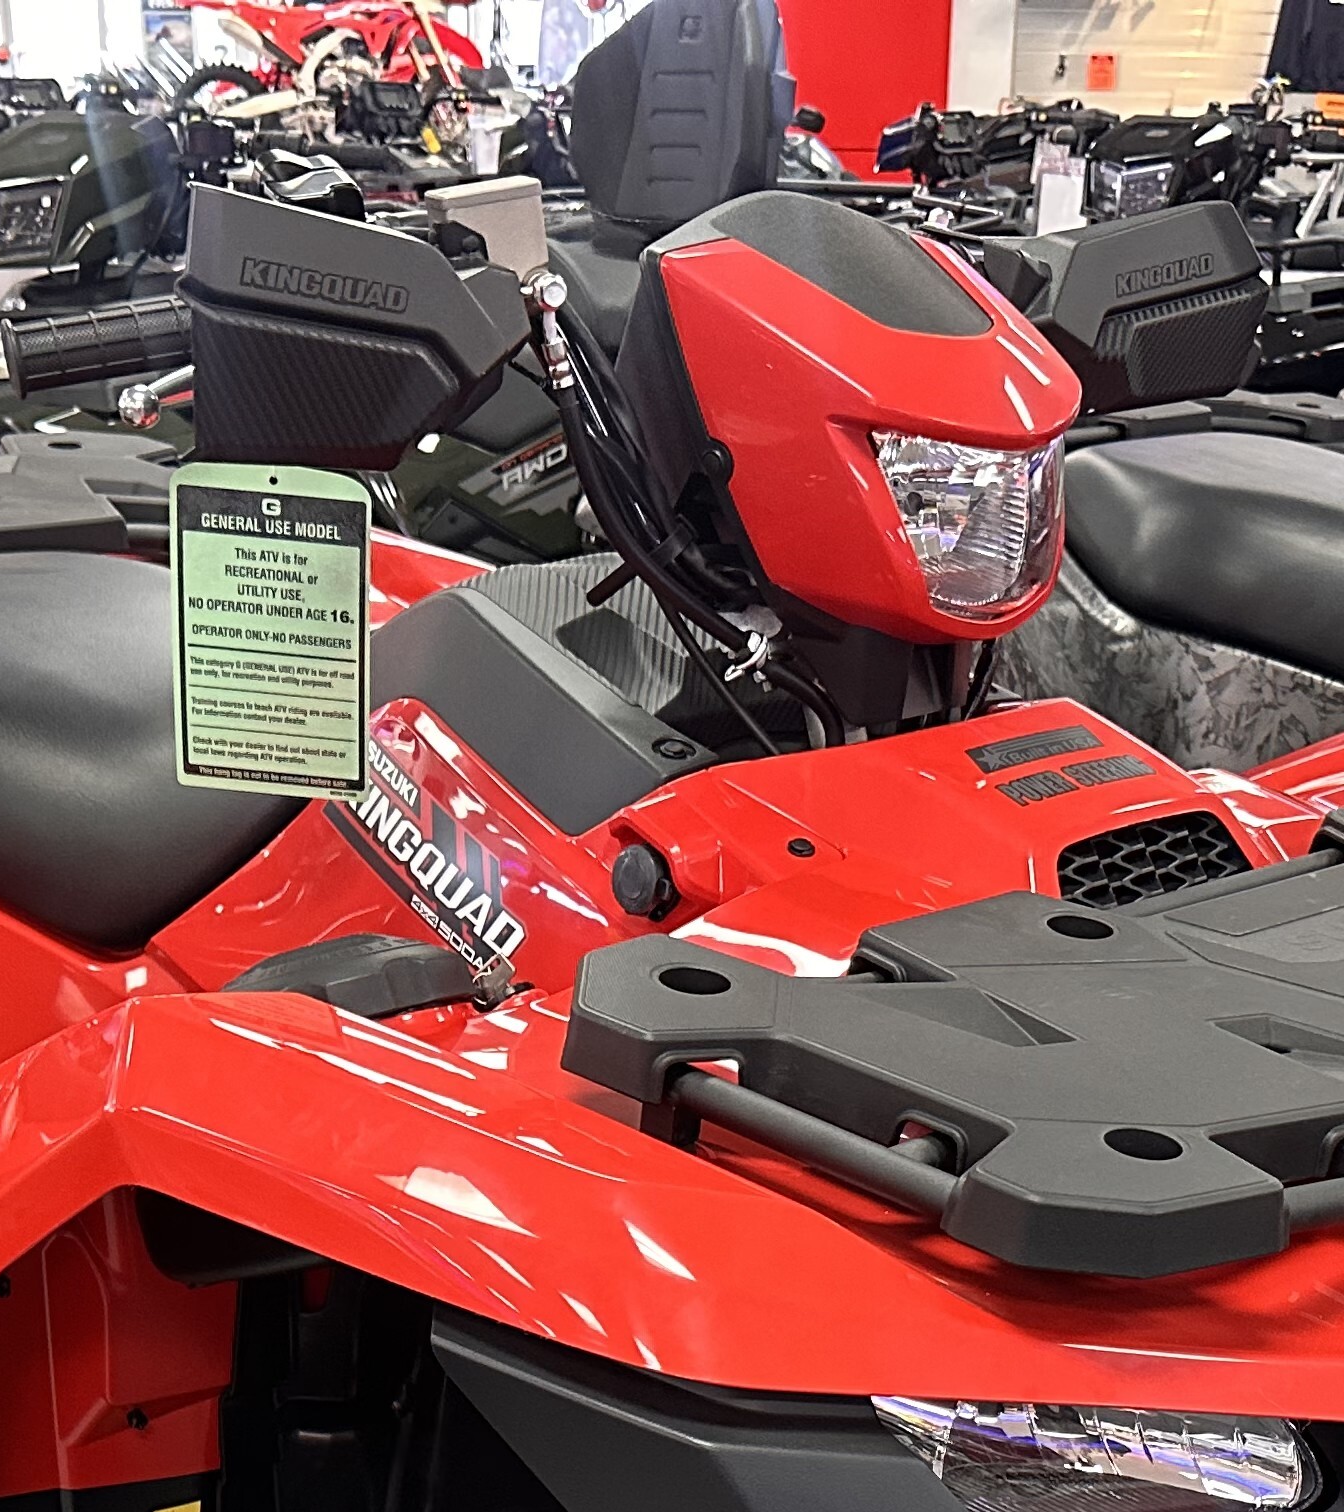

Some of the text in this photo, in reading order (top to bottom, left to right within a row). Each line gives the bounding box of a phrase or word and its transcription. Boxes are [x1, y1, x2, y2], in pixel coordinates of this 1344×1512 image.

[241, 257, 408, 314] KINGQUAD
[1116, 253, 1215, 298] KINGQUAD
[500, 443, 568, 491] AWD
[261, 498, 282, 517] G
[201, 513, 342, 541] GENERAL USE MODEL
[234, 547, 308, 566] This ATV is for
[224, 564, 319, 585] RECREATIONAL or
[237, 583, 278, 599] UTILITY
[188, 597, 355, 624] NO OPERATOR UNDER AGE 16.
[191, 624, 243, 639] OPERATOR
[288, 633, 353, 650] PASSENGERS
[1059, 736, 1100, 752] USA
[367, 741, 420, 807] SUZUKI
[995, 754, 1157, 807] POWER STEERING
